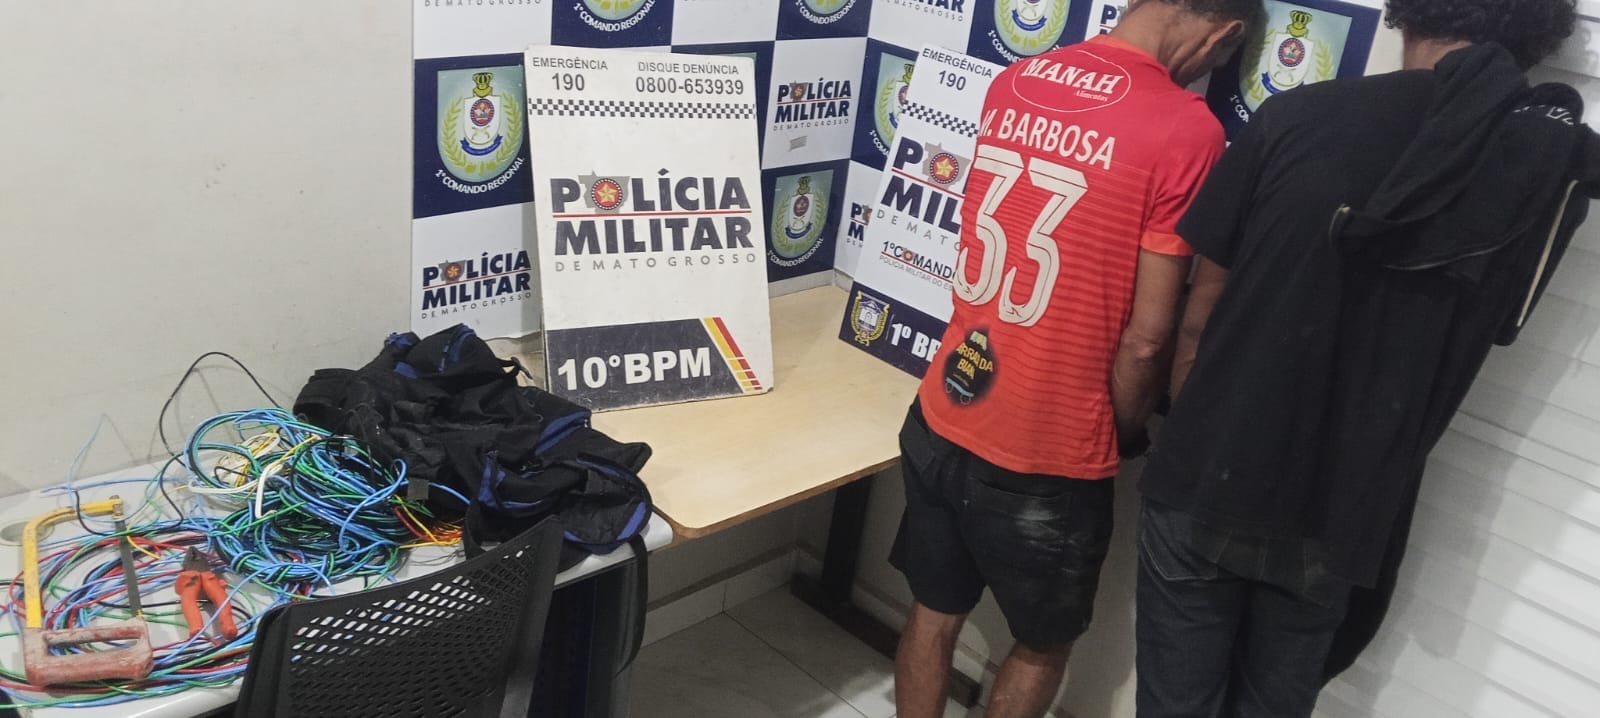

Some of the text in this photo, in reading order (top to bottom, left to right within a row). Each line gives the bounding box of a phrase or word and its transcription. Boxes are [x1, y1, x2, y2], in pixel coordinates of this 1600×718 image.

[580, 11, 620, 32] COMANDO
[620, 0, 656, 30] REGIONAL
[532, 57, 608, 70] EMERGÊNCIA
[922, 47, 993, 78] EMERGÊNCIA
[992, 38, 1022, 62] COMAND
[552, 73, 585, 91] 190
[638, 61, 739, 75] DISQUE DENÚNCIA
[939, 70, 967, 91] 190
[1021, 58, 1123, 94] MANAH
[635, 76, 744, 95] 0800-653939
[777, 77, 852, 103] POLÍCIA
[774, 100, 850, 123] MILITAR
[998, 108, 1116, 170] BARBOSA
[442, 176, 487, 194] COMANDO
[487, 157, 524, 191] REGIONAL
[550, 167, 751, 214] POLÍCIA
[876, 209, 899, 226] DE
[554, 216, 754, 256] MILITAR
[952, 144, 1089, 327] 33
[422, 250, 531, 288] POLÍCIA
[555, 253, 756, 273] DE MATO GROSSO
[421, 272, 532, 311] MILITAR
[421, 292, 532, 319] DE MATO GROSSO
[911, 331, 943, 363] BP
